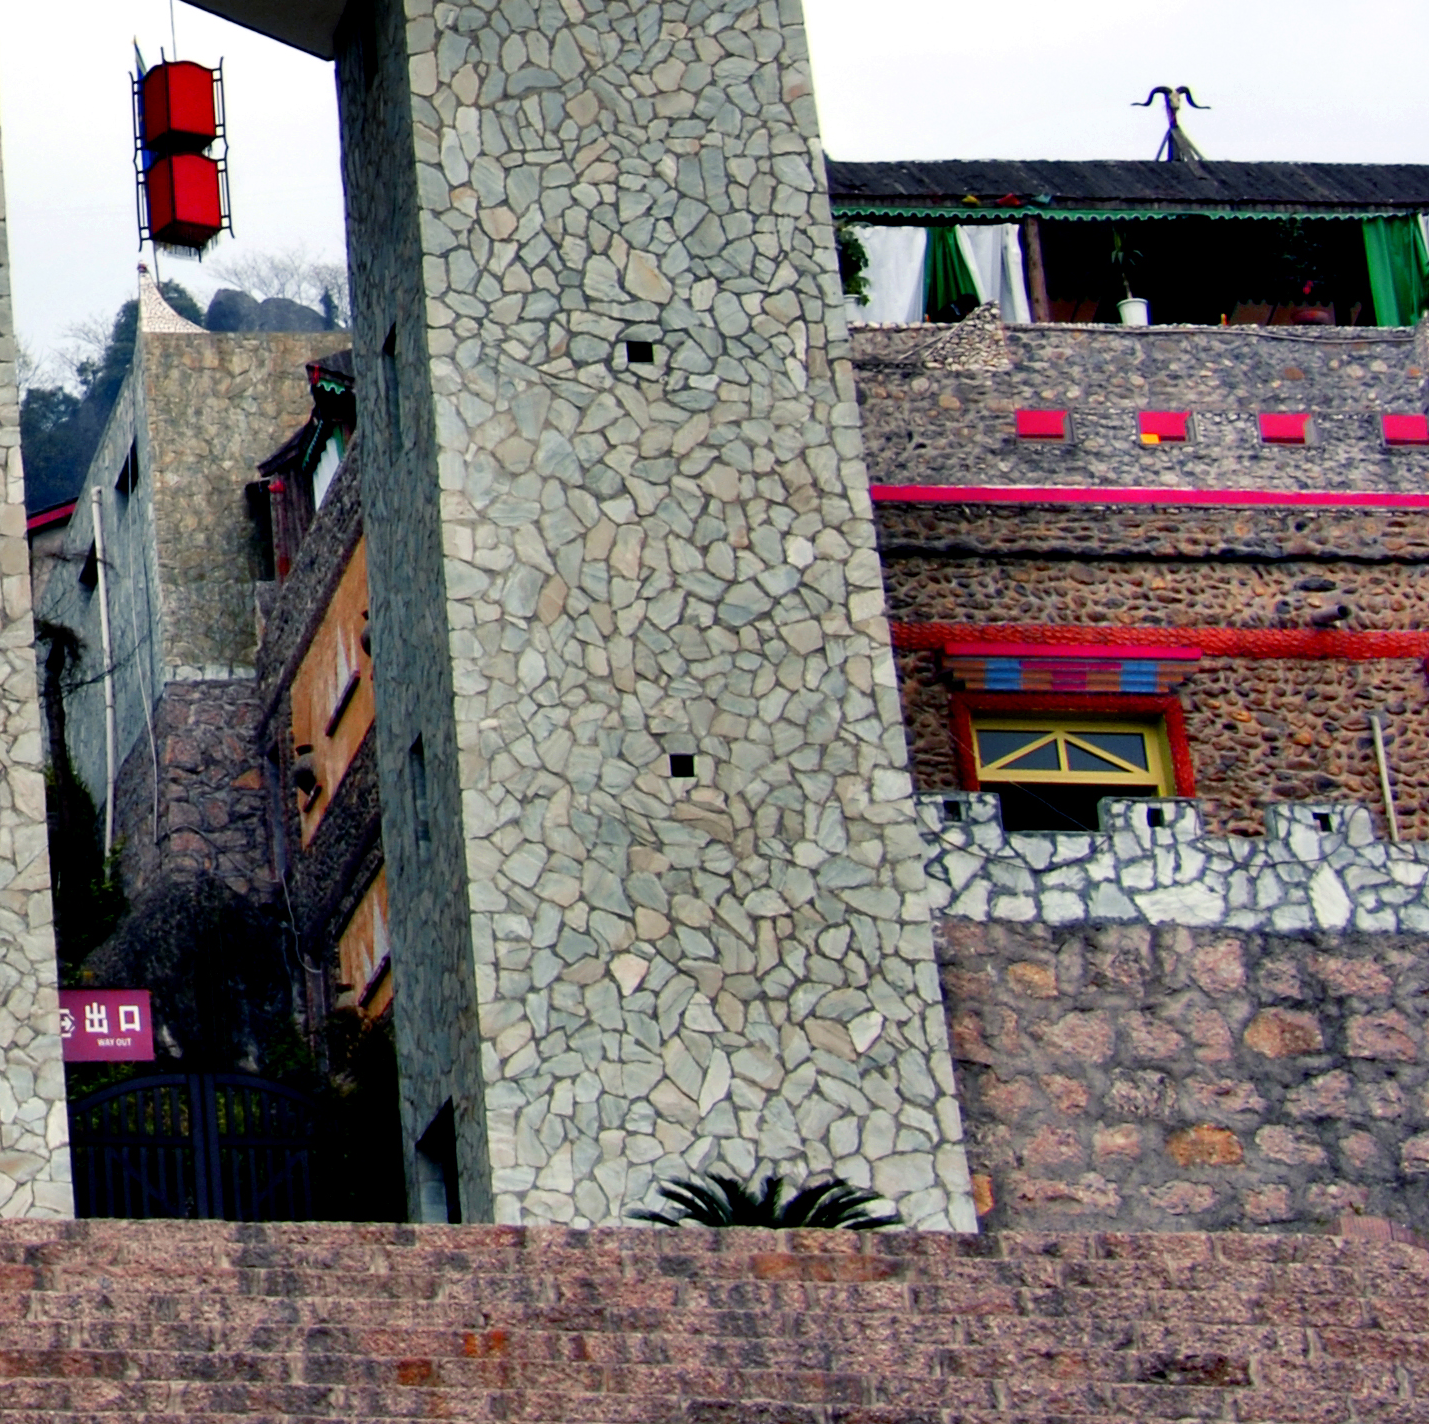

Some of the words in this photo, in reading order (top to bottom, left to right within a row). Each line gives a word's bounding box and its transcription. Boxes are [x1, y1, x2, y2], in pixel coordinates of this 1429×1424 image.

[84, 1001, 141, 1034] 出口
[97, 1037, 115, 1047] WAY
[115, 1037, 132, 1047] OUT
